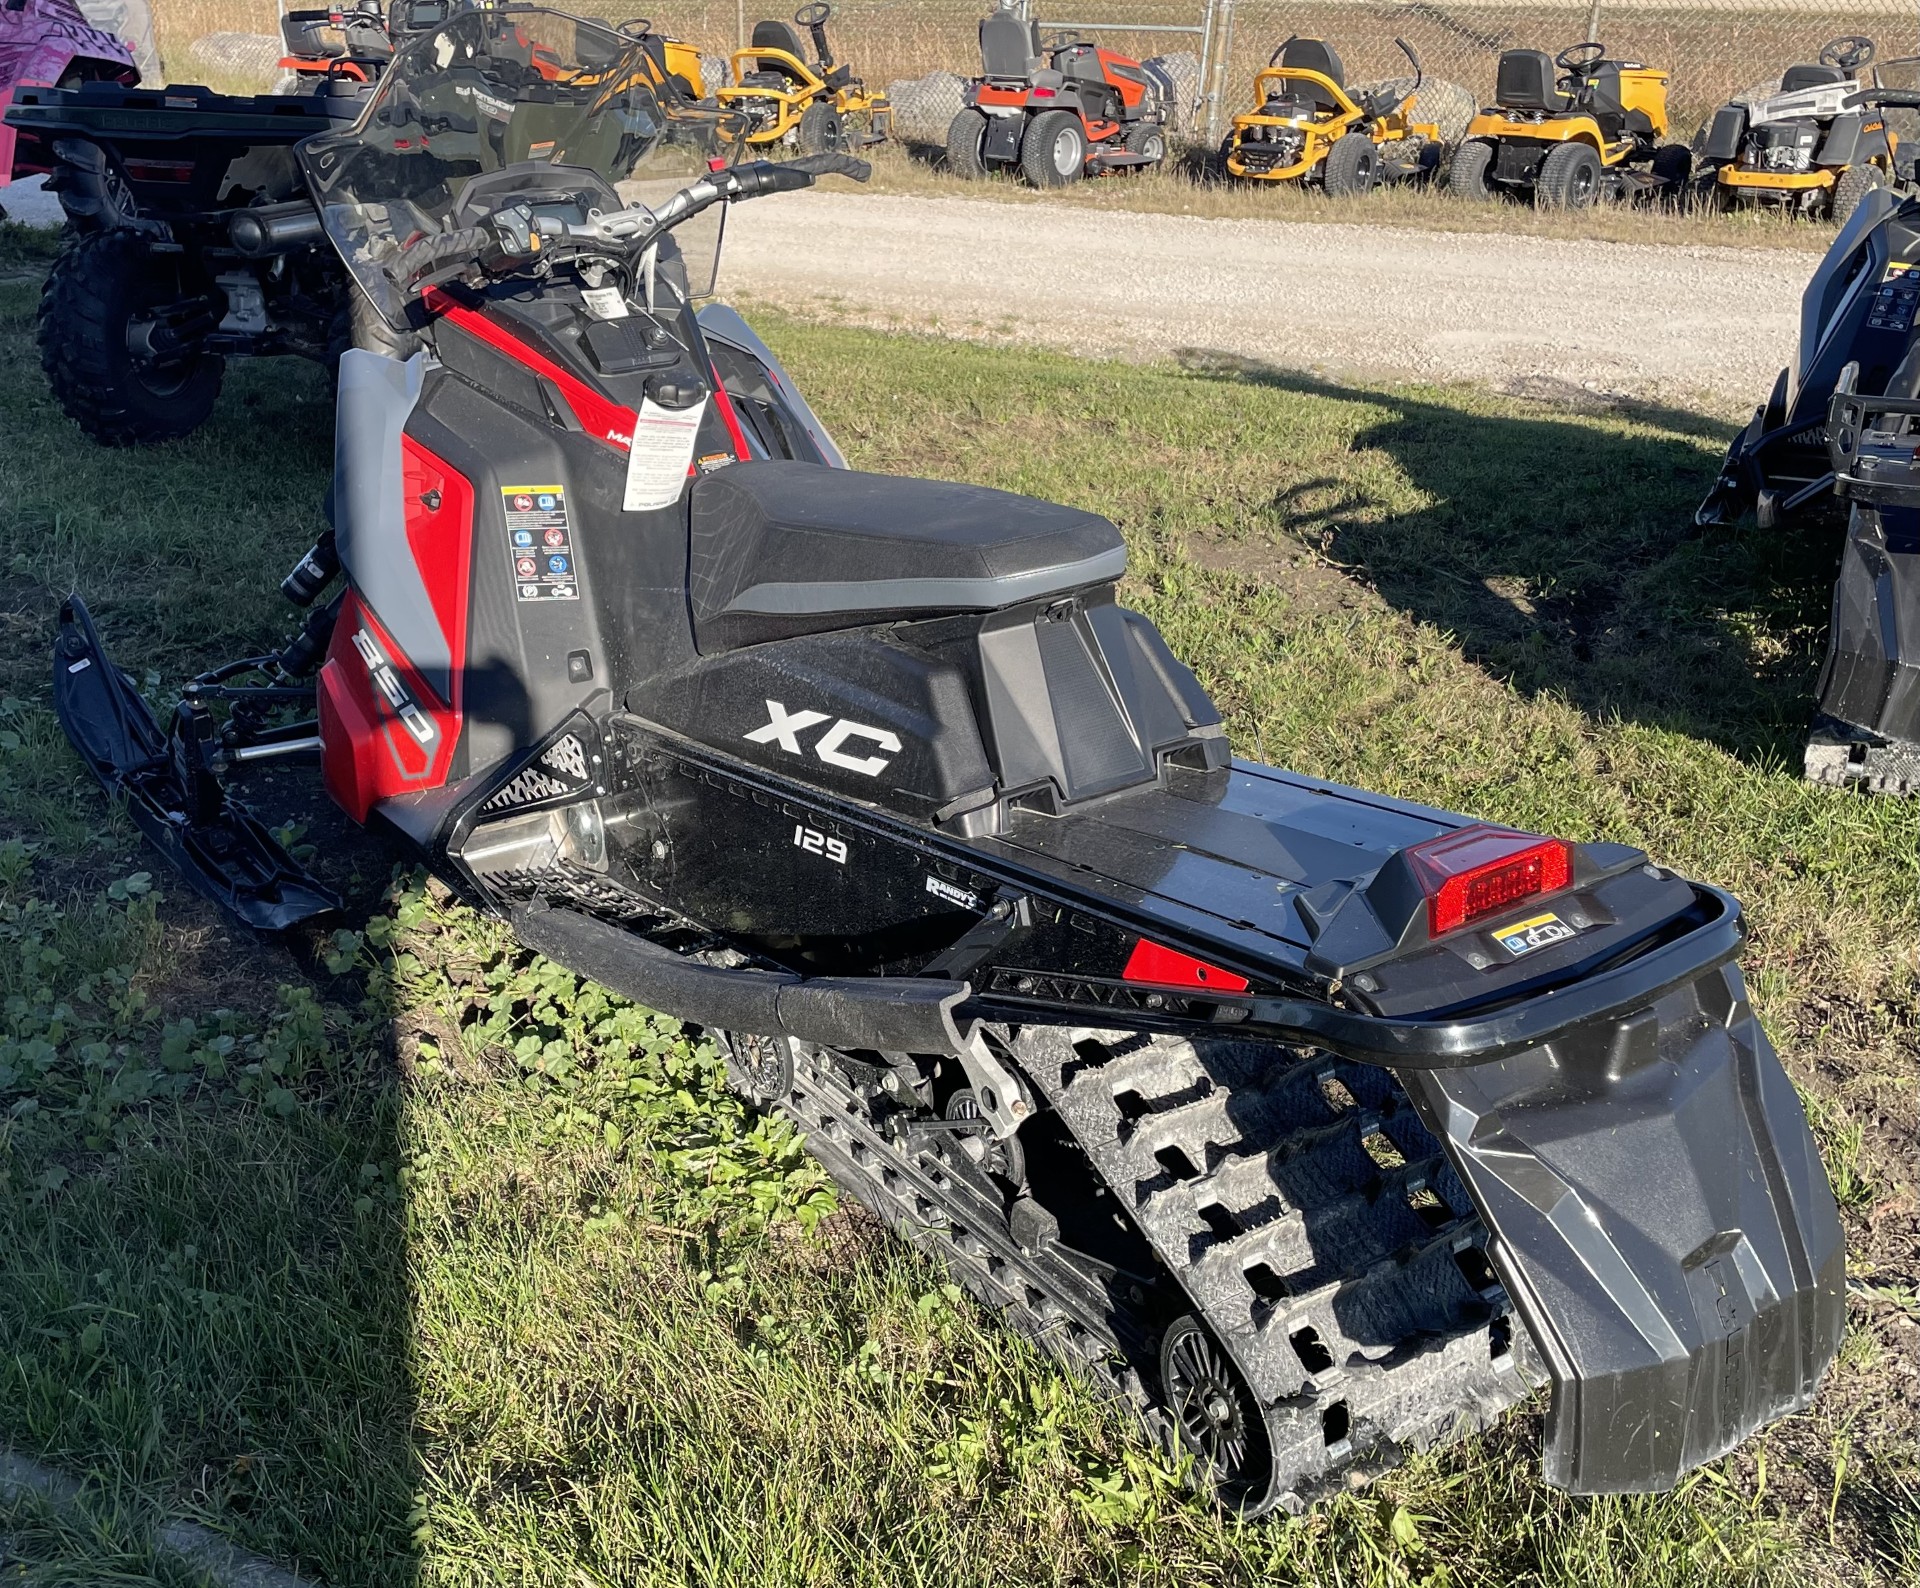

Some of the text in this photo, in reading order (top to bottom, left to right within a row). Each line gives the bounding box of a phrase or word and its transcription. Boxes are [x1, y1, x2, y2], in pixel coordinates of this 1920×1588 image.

[351, 628, 434, 743] 850
[743, 699, 902, 777] XC
[793, 824, 848, 865] 129
